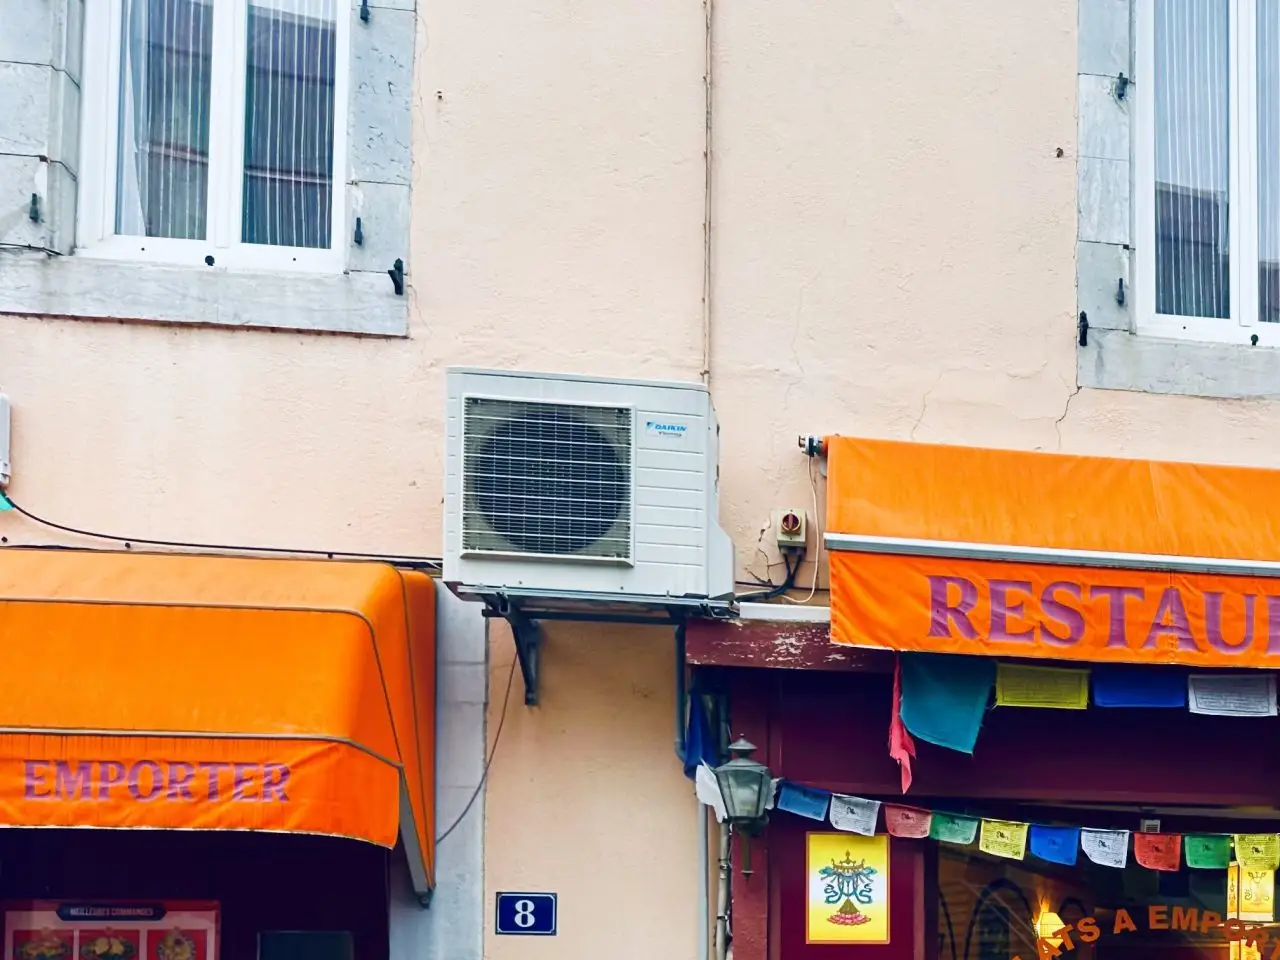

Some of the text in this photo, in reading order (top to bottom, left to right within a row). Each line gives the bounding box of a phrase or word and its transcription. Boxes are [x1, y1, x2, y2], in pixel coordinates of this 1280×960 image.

[23, 759, 291, 801] EMPORTER
[514, 900, 535, 927] 8
[1113, 909, 1137, 934] A
